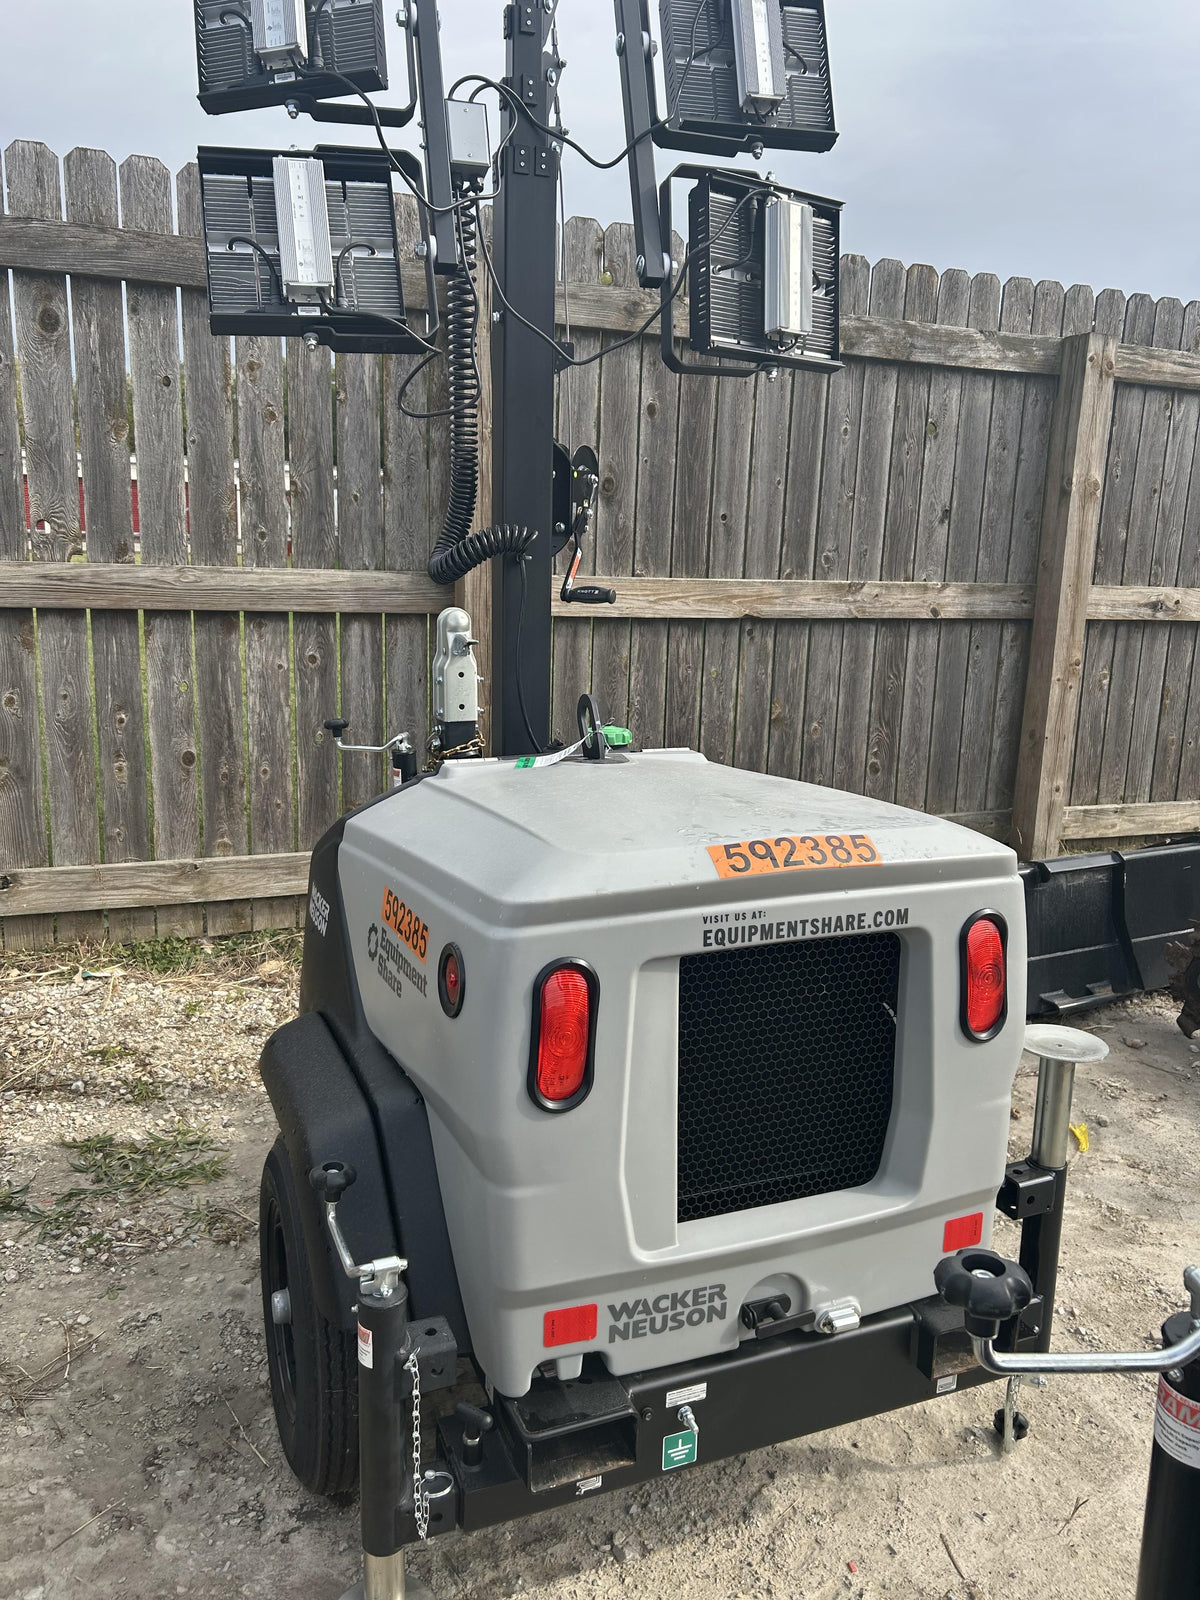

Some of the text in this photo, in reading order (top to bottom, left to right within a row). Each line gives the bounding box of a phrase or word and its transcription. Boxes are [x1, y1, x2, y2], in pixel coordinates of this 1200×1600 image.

[723, 834, 877, 873] 592385
[385, 889, 429, 958] 592385
[702, 910, 767, 925] VISIT US AT:
[702, 908, 909, 947] EQUIPMENTSHARE.COM
[377, 953, 402, 998] Share
[380, 927, 428, 998] Equipment
[607, 1283, 728, 1322] WACKER
[608, 1302, 728, 1344] NEUSON
